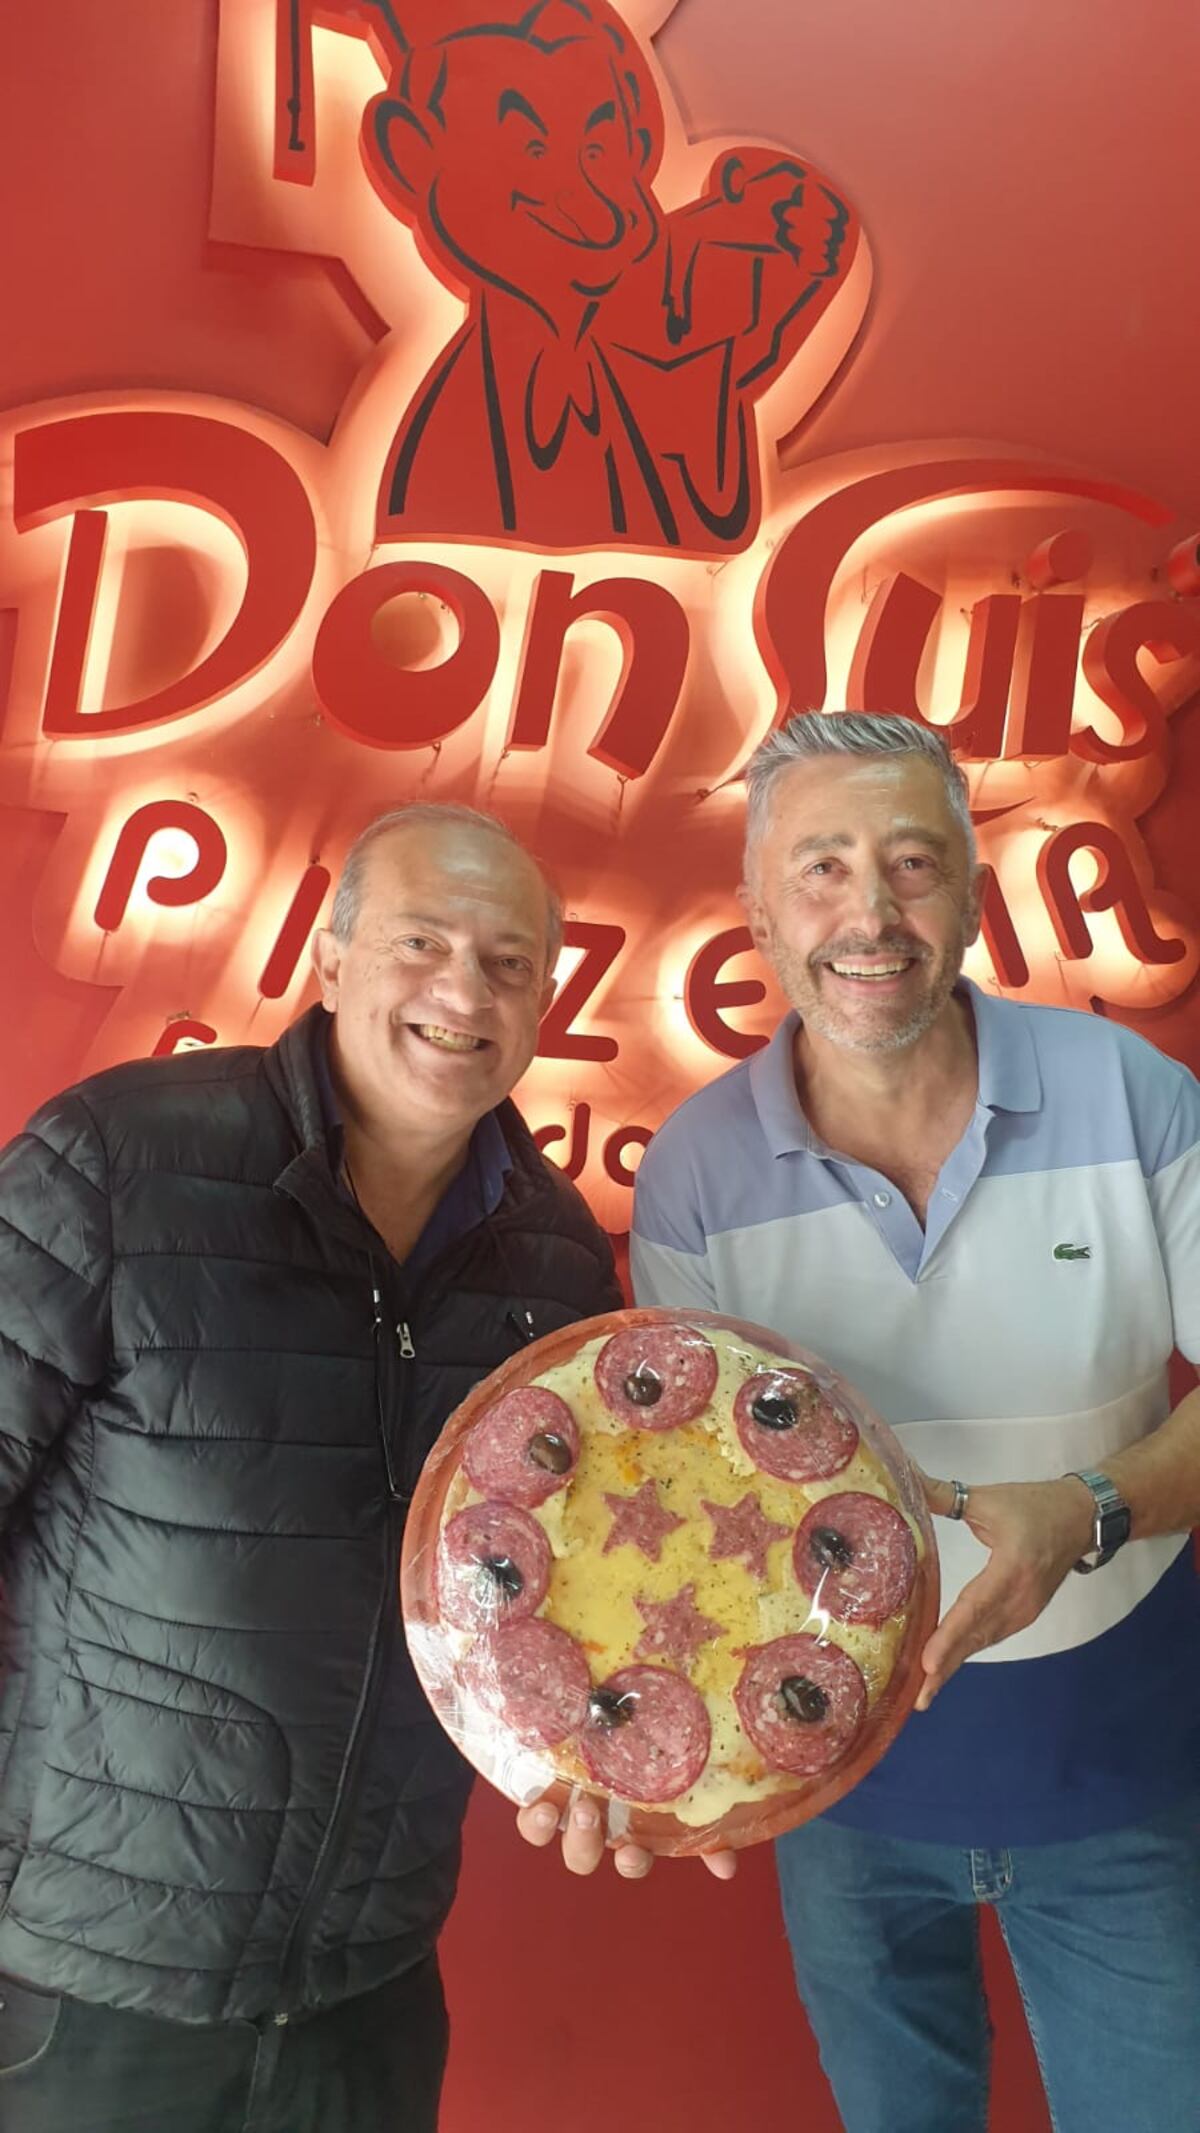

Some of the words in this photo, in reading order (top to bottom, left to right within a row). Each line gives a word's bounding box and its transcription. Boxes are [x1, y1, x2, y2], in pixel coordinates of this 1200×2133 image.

[13, 411, 690, 779] Don
[712, 458, 1200, 826] Luis
[94, 800, 1187, 1063] PIZEIA
